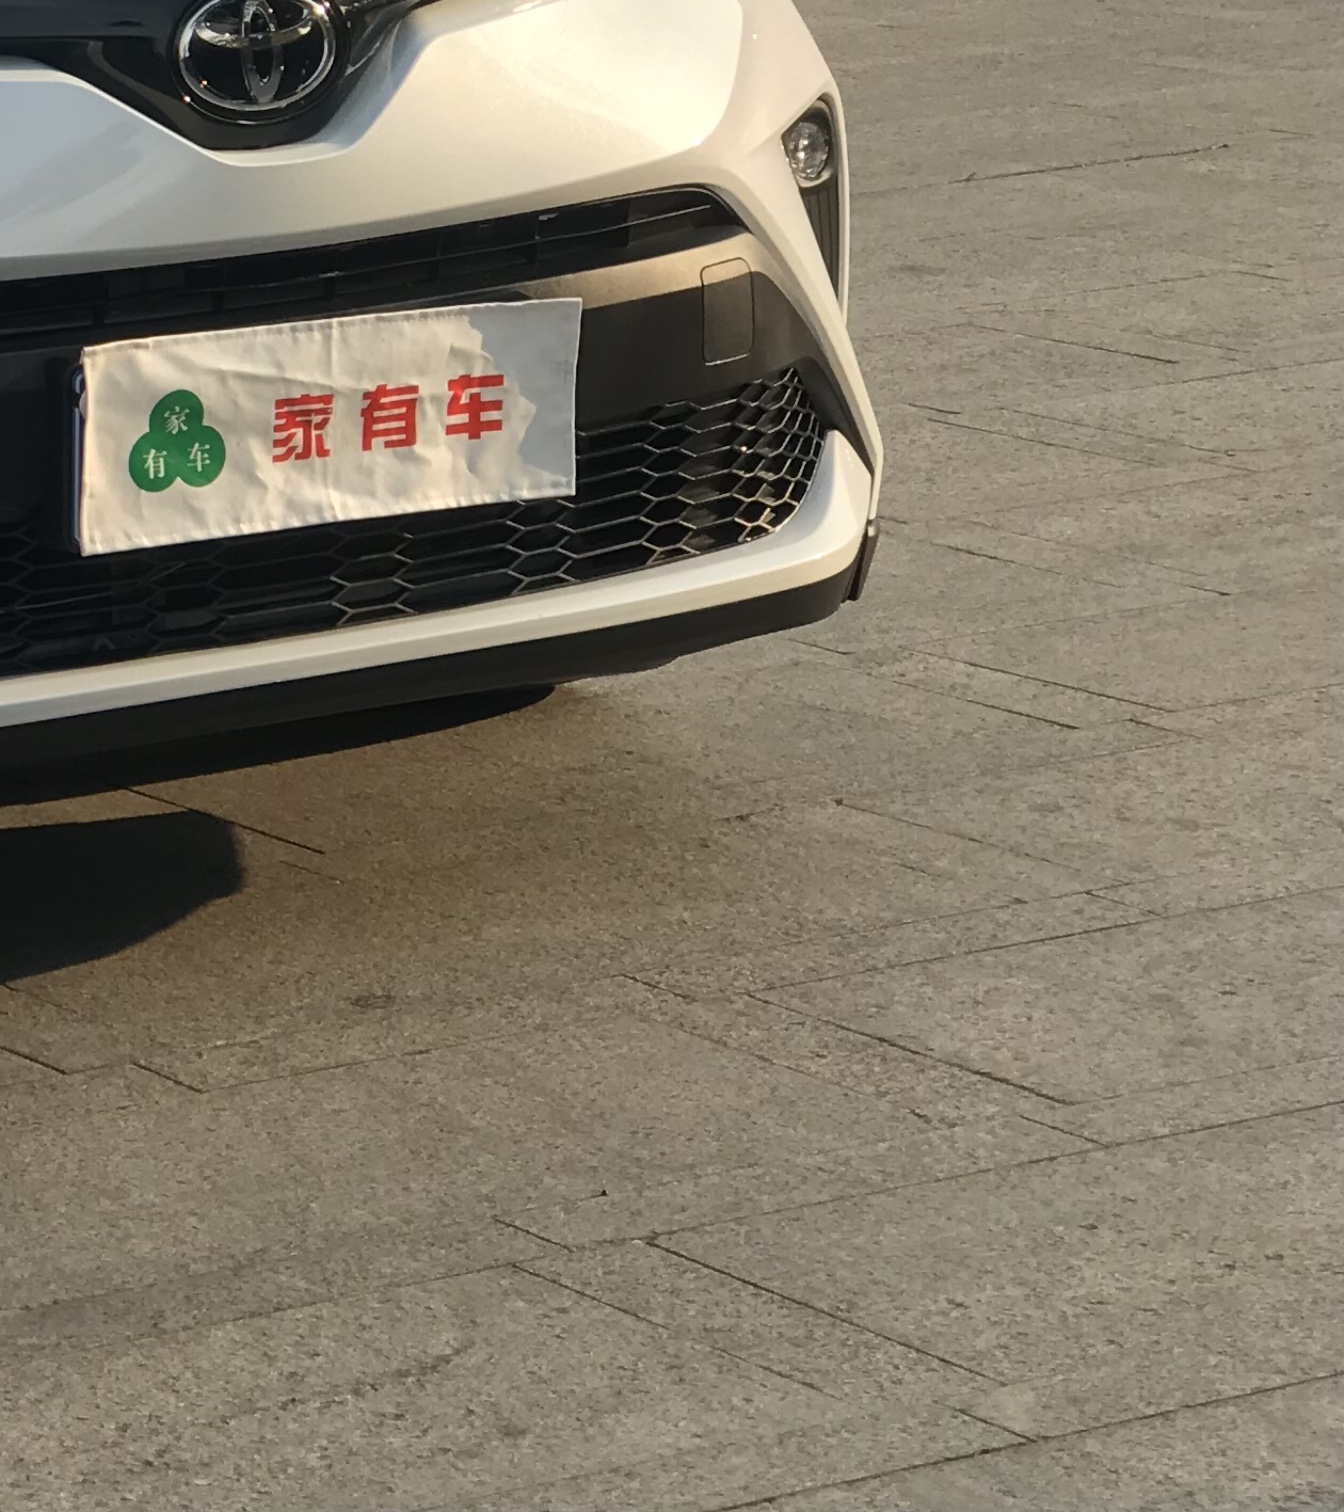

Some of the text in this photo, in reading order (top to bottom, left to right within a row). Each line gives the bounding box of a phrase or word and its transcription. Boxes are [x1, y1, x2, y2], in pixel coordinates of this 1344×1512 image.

[163, 405, 190, 435] 家
[272, 374, 505, 463] 家有车
